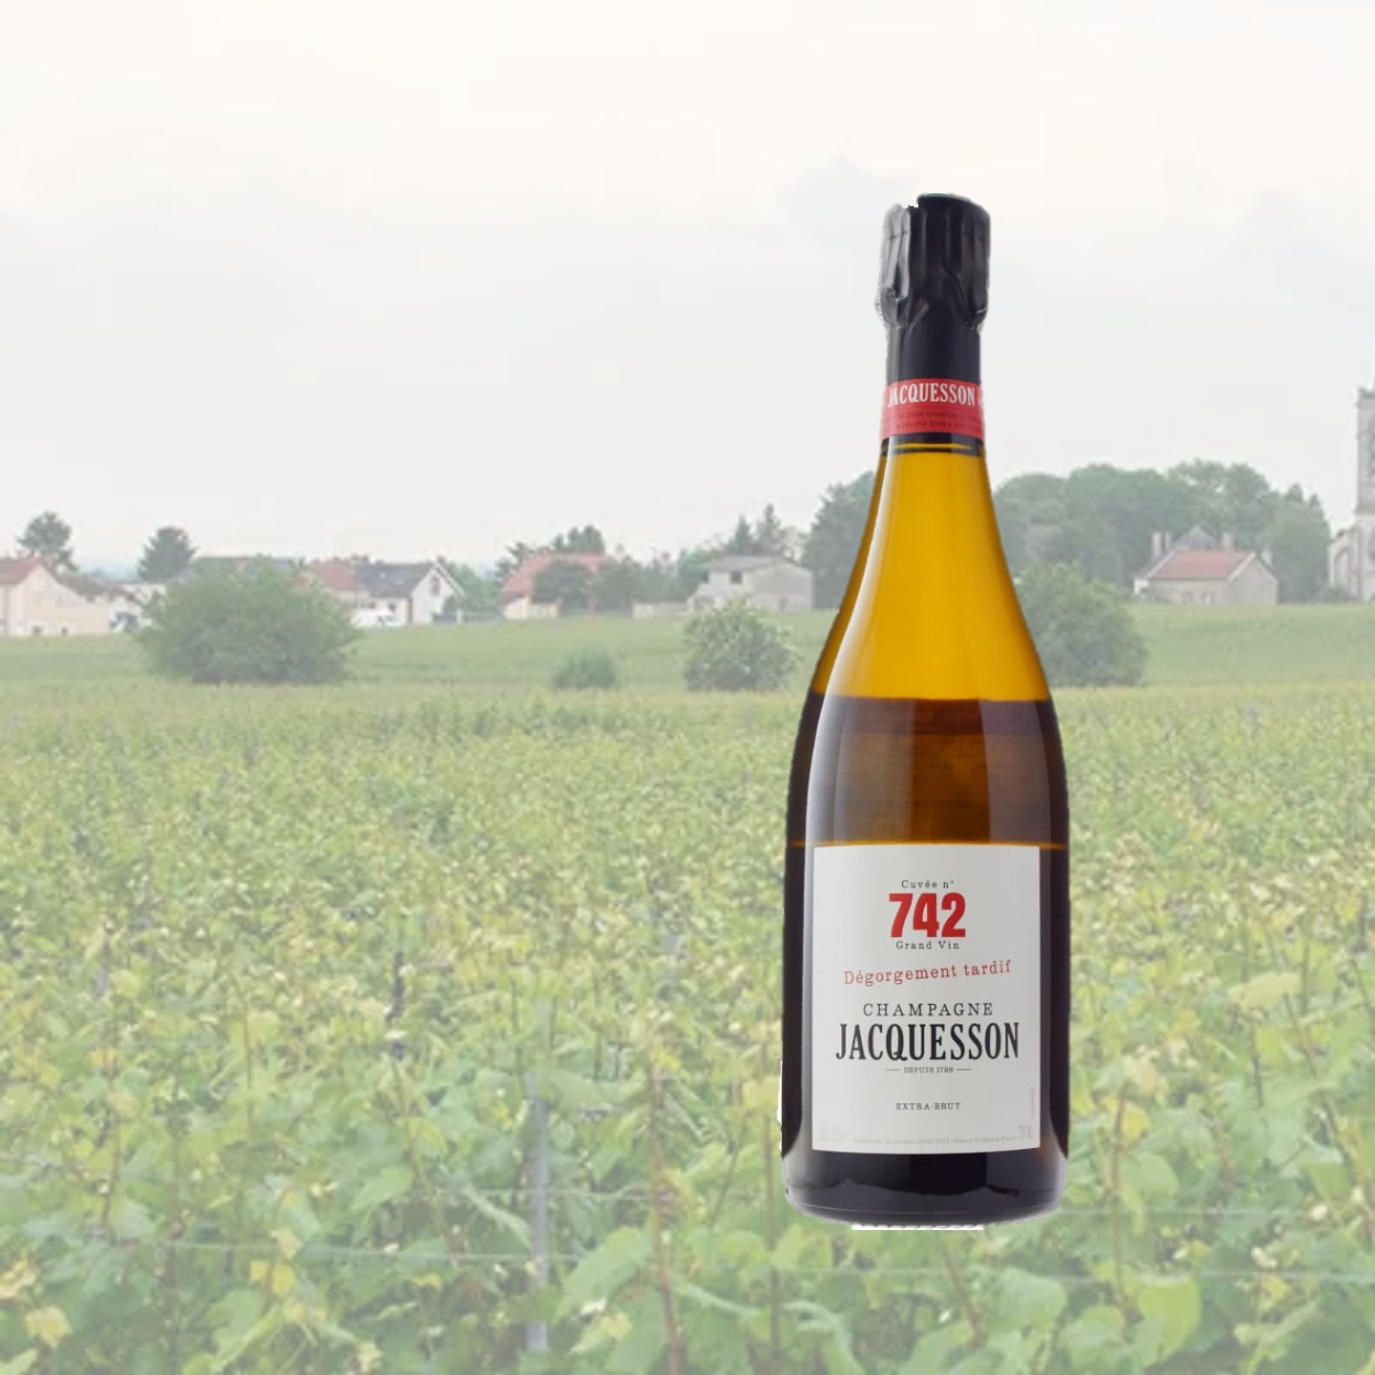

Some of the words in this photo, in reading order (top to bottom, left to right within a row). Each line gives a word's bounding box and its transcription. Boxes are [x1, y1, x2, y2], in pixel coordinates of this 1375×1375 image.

[887, 382, 975, 407] JACQUESSON
[901, 879, 938, 889] Cuvée
[888, 891, 967, 938] 742
[895, 940, 933, 951] Grand
[938, 940, 960, 950] Vin
[844, 965, 957, 987] Dégorgement
[963, 959, 1012, 977] tardif
[863, 1002, 994, 1017] CHAMPAGNE
[835, 1022, 1020, 1062] JACQUESSON
[903, 1066, 935, 1074] DEPUIS
[895, 1102, 961, 1111] EXTRA-BRUT
